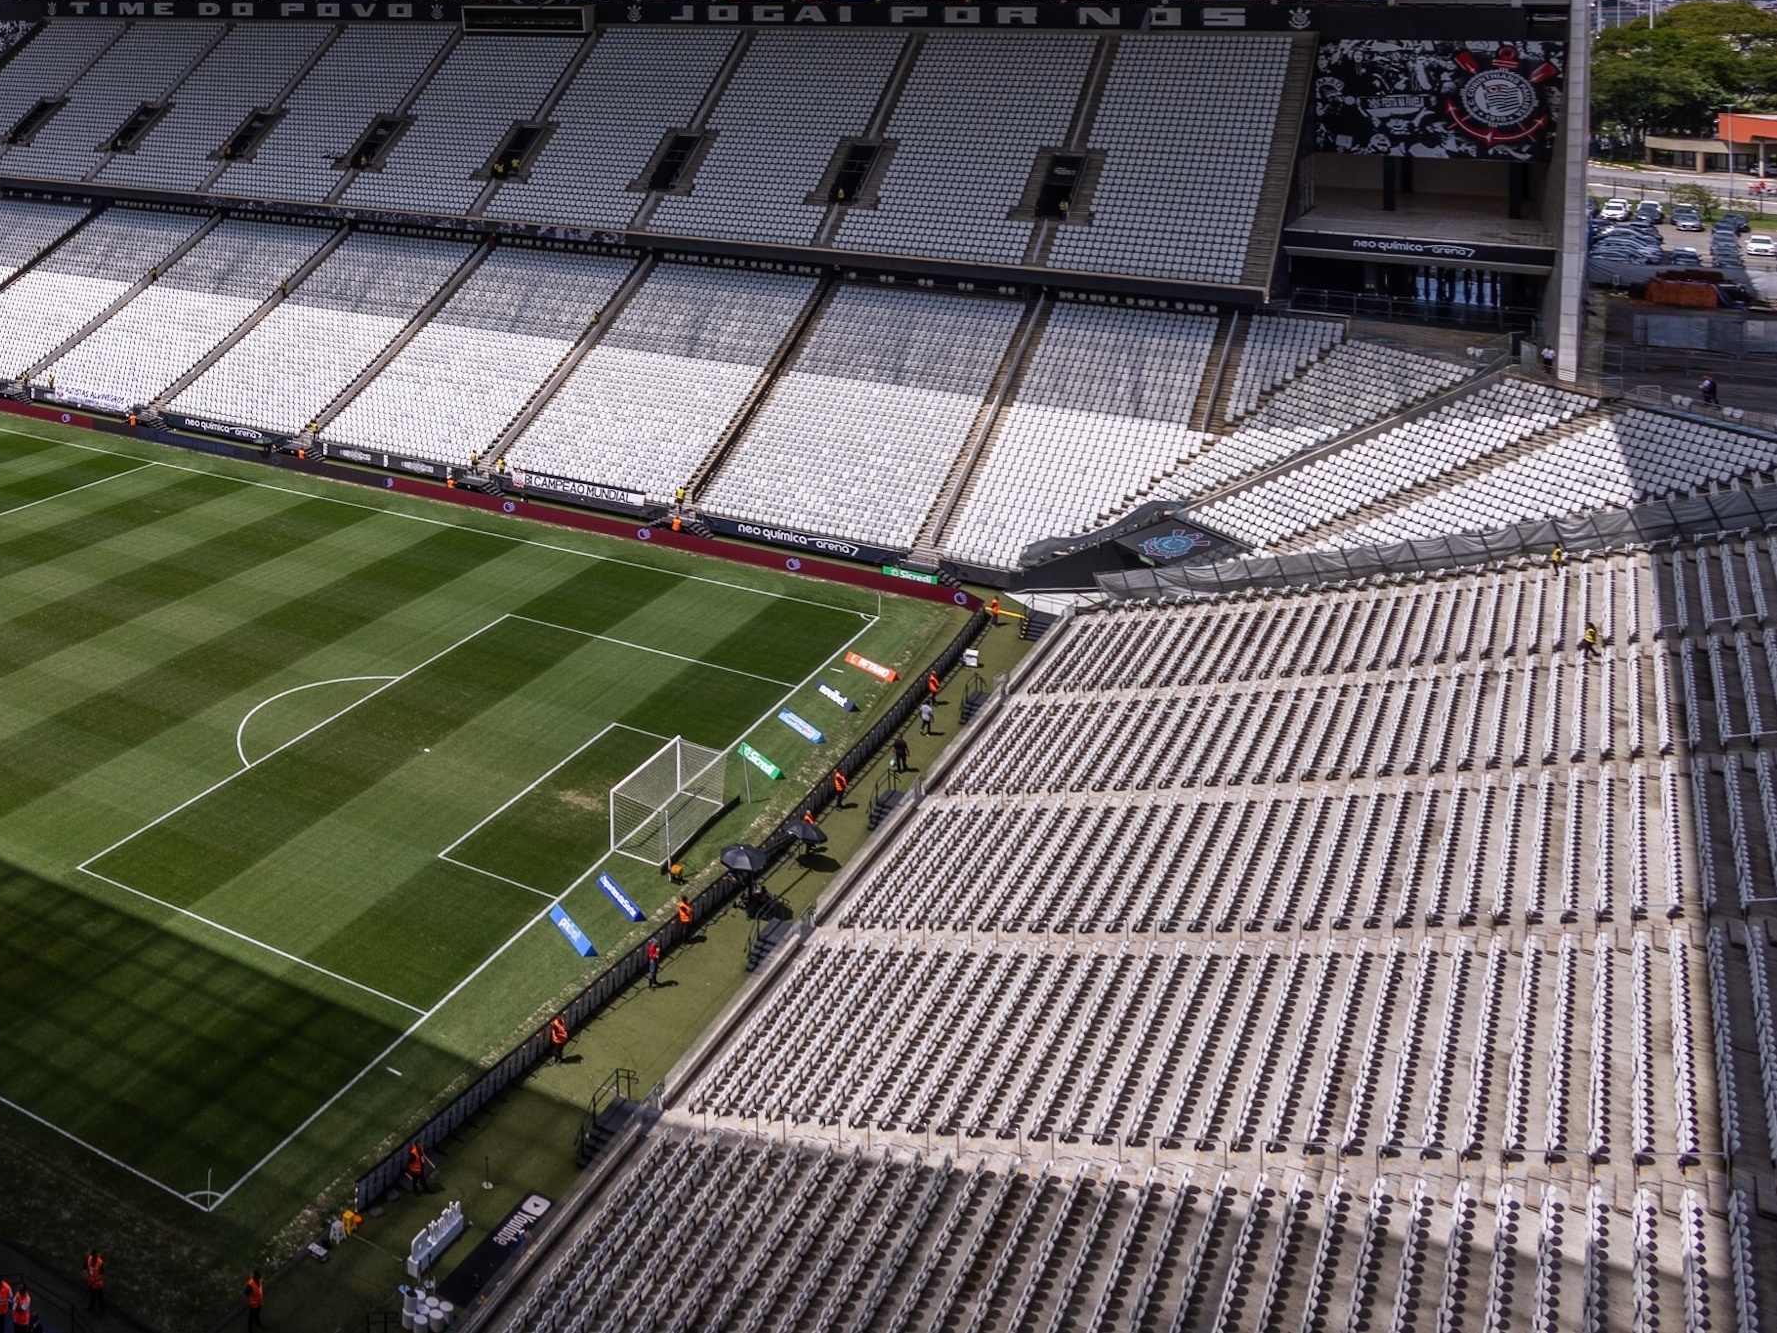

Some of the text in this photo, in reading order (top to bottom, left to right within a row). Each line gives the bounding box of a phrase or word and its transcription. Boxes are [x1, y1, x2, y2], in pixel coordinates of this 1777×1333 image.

[69, 2, 413, 18] TIME DO POVO
[670, 5, 853, 23] JOGAI
[890, 6, 1038, 24] POR
[1467, 73, 1520, 97] CORINTHIANS
[1485, 114, 1507, 122] 1910
[1352, 239, 1467, 257] neo química arena
[185, 418, 200, 427] neo
[586, 487, 634, 504] MUNDIAL
[738, 523, 850, 554] neo química arena
[899, 570, 932, 584] Sicredi
[492, 1211, 537, 1246] YouTube
